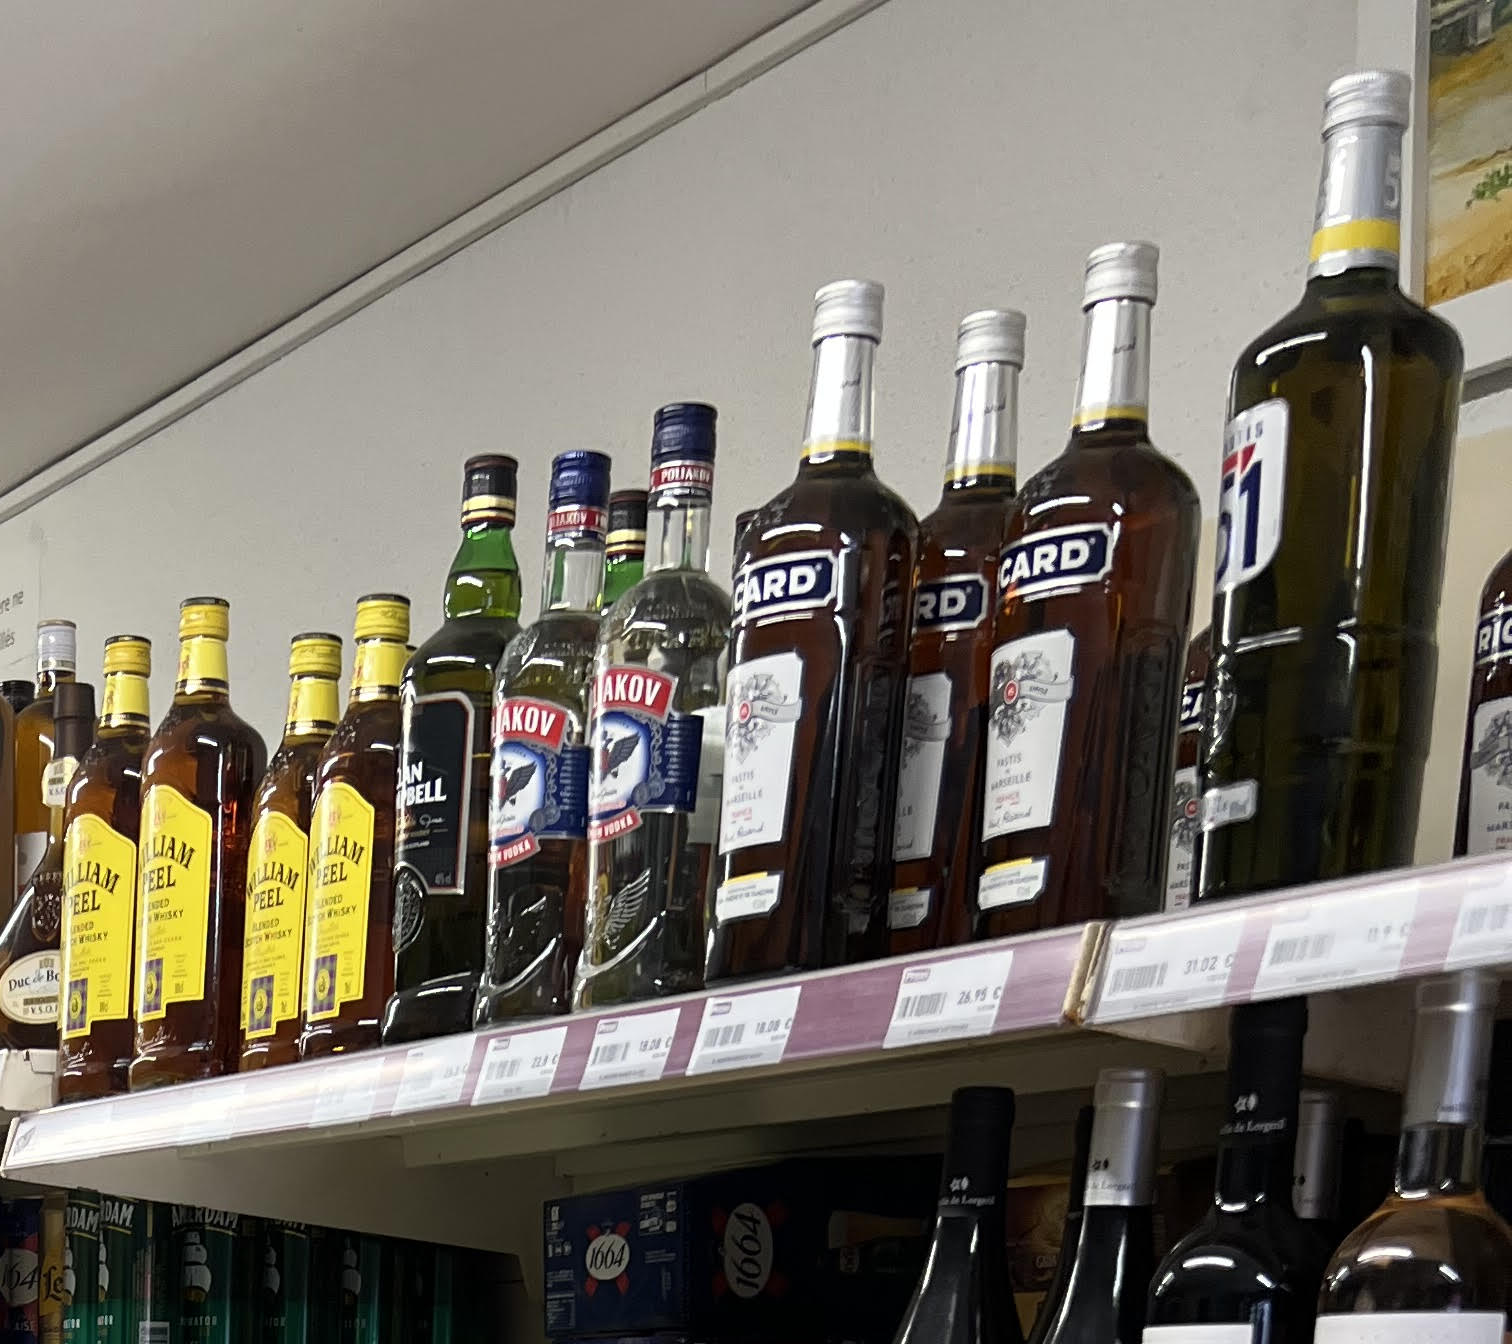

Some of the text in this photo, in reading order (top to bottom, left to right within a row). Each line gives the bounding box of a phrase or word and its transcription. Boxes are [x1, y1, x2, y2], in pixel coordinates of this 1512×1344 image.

[316, 861, 349, 888] PEEL
[253, 886, 285, 912] PEEL
[8, 972, 32, 992] Duc
[589, 1243, 626, 1270] 1664
[734, 1208, 762, 1295] 1664
